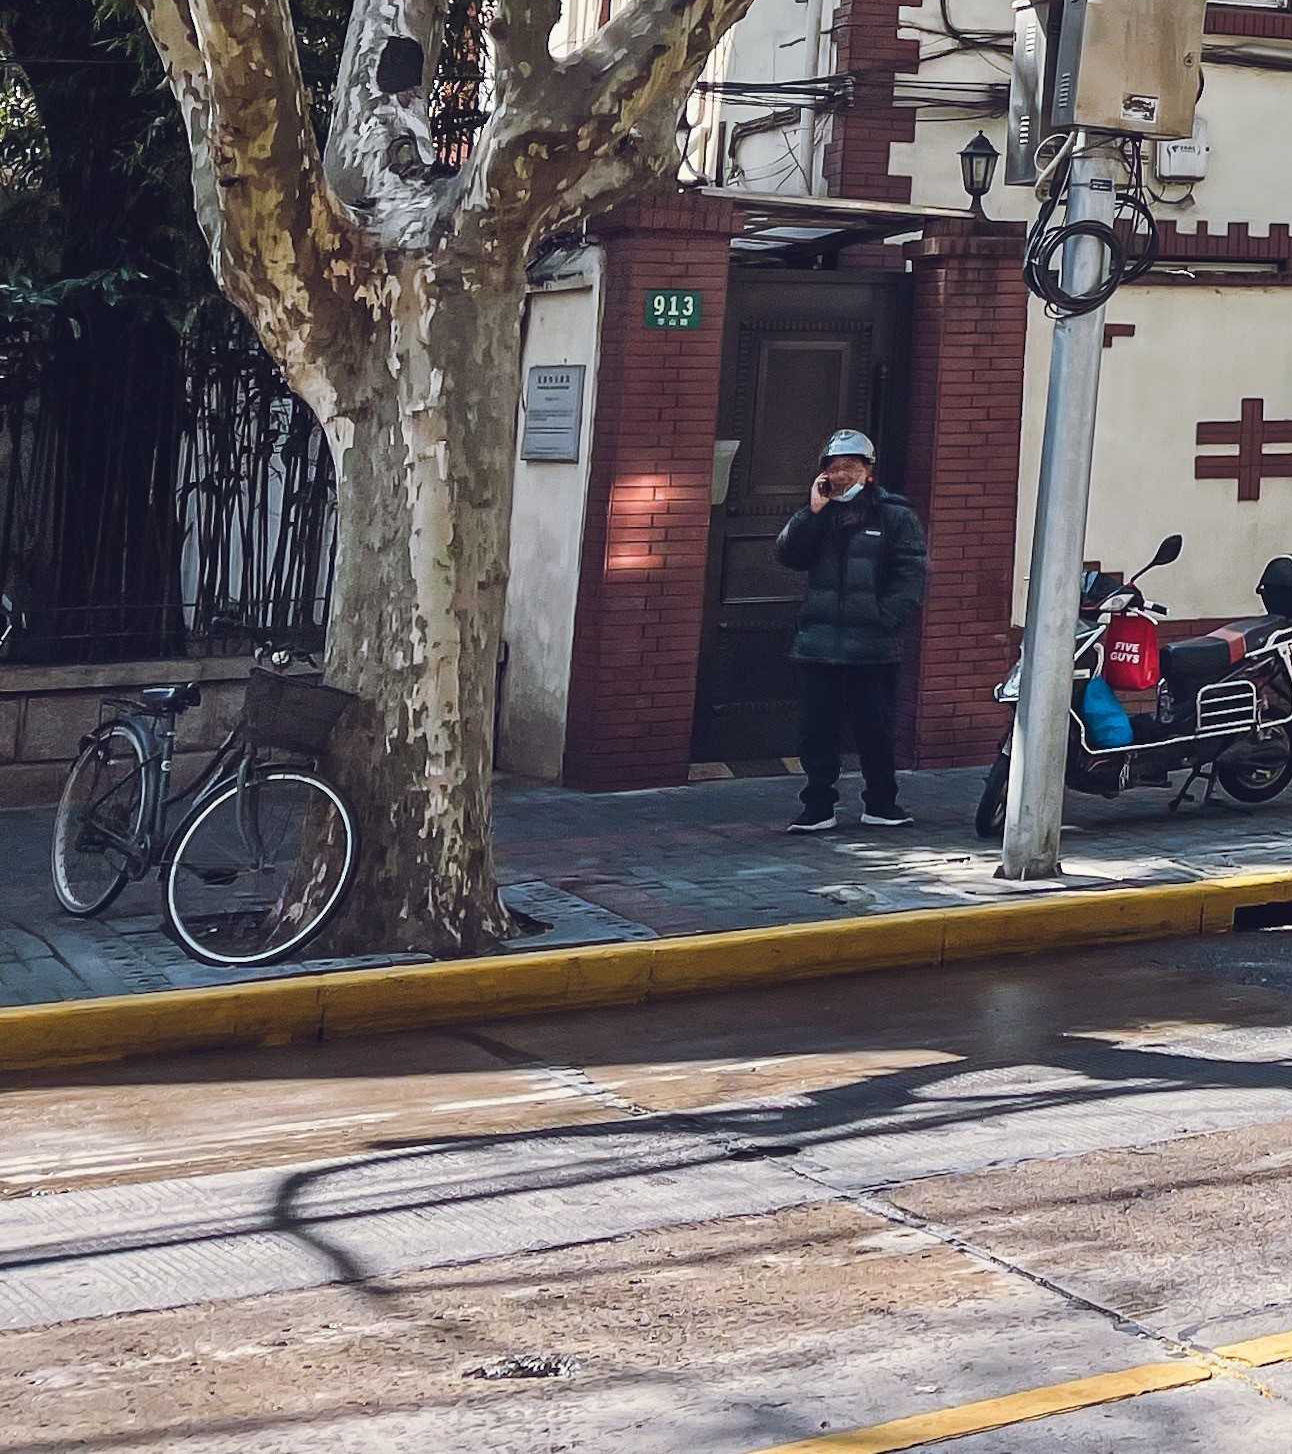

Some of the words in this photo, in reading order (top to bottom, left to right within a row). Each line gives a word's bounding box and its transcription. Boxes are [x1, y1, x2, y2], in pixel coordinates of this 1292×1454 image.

[653, 295, 694, 316] 913
[1114, 641, 1140, 653] FIVE
[1110, 651, 1140, 664] GUYS
